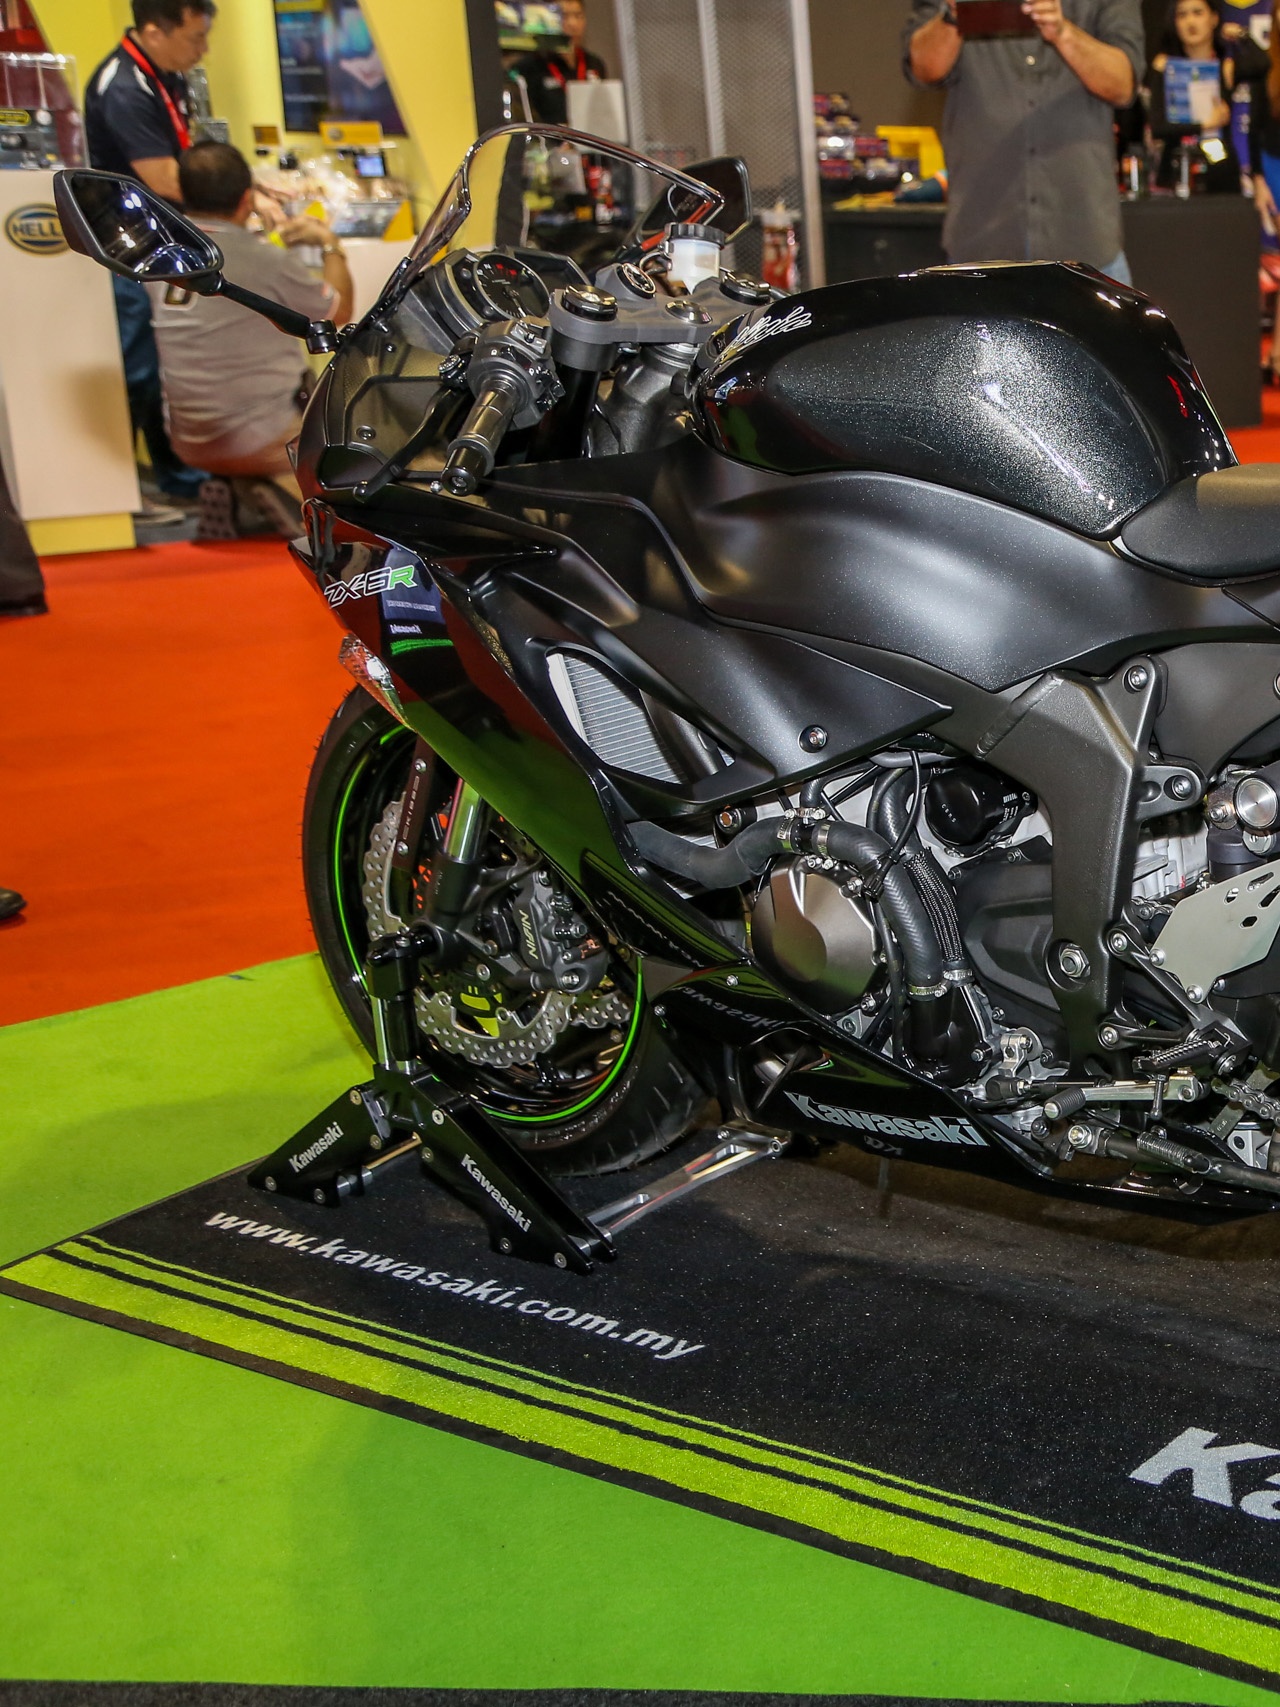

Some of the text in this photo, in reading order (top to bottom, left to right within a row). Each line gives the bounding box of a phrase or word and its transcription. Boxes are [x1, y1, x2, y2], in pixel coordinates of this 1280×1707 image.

[12, 220, 64, 238] HELL
[323, 564, 418, 609] ZX-6R
[782, 1090, 991, 1147] Kawasaki
[287, 1121, 345, 1174] Kawasaki
[460, 1153, 533, 1233] Kawasaki
[205, 1211, 705, 1362] www.kawasaki.com.my
